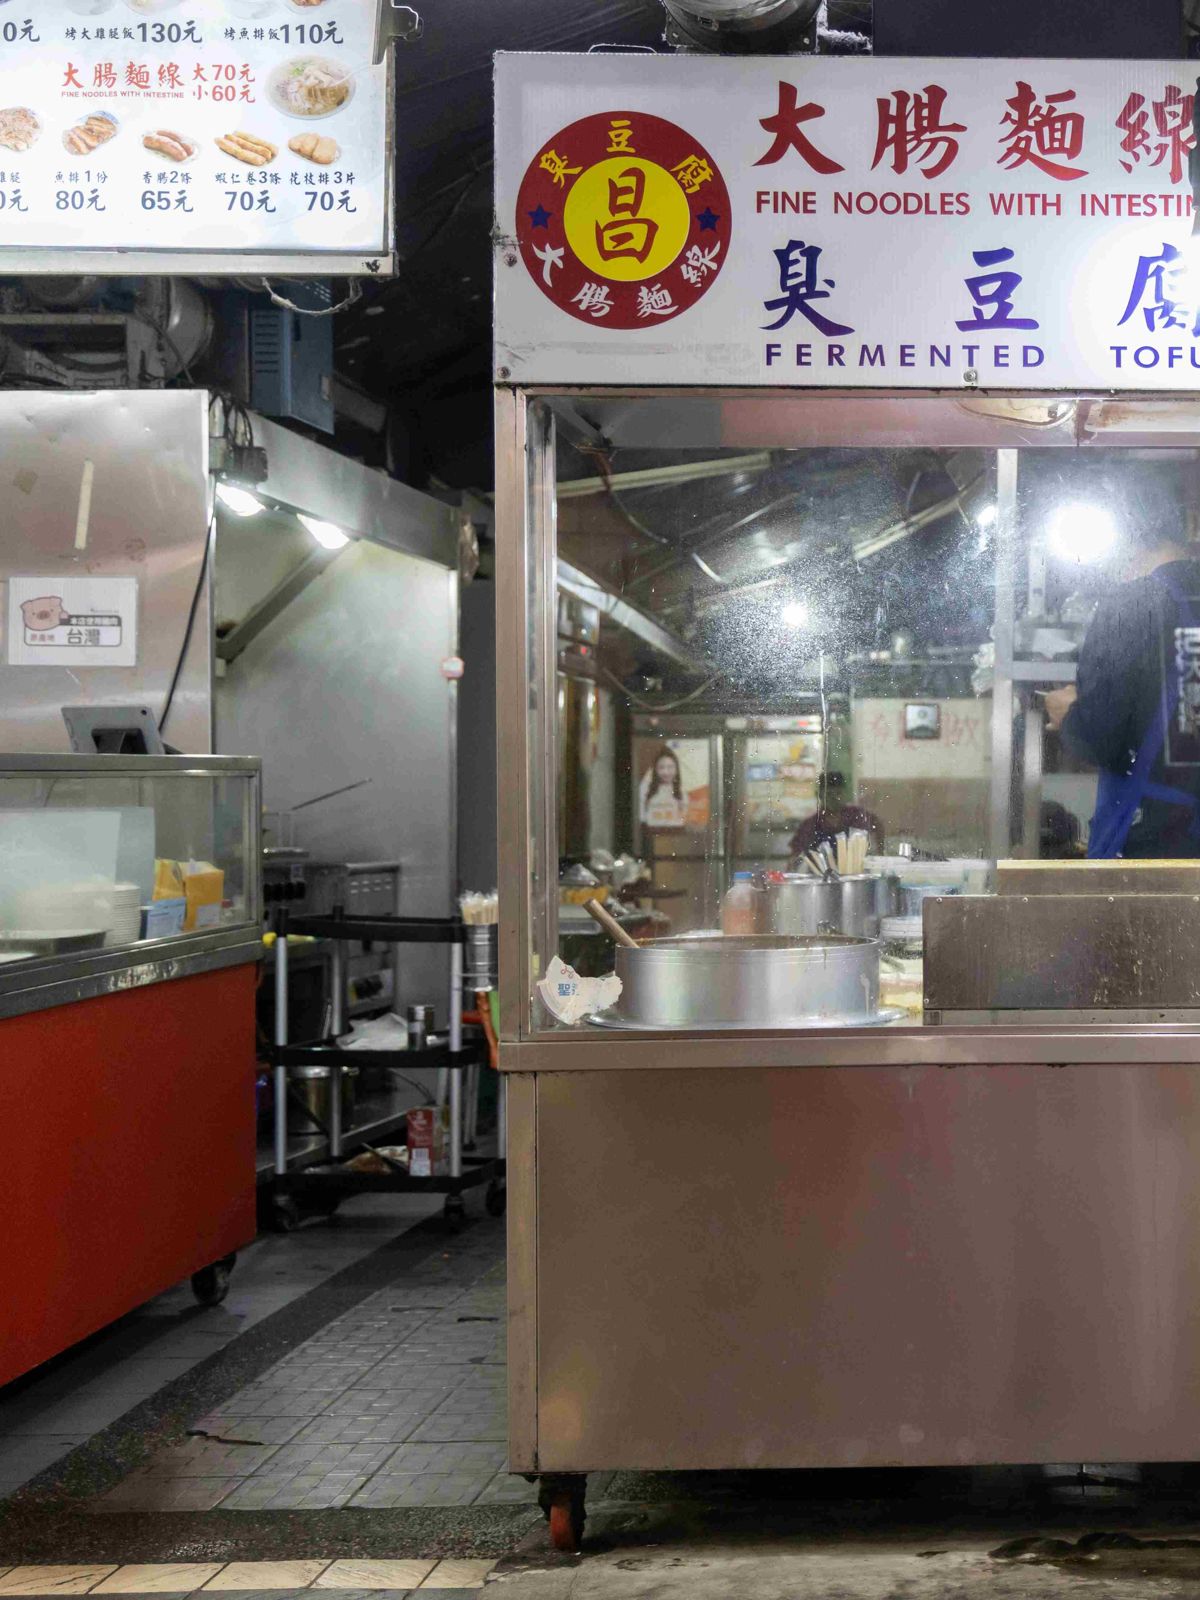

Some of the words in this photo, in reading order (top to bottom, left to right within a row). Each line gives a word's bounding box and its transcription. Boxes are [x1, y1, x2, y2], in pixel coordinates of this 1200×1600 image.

[136, 20, 203, 44] 130元
[279, 20, 345, 44] 110元
[61, 61, 185, 89] 大腸麵線
[192, 62, 256, 83] 大70元
[143, 91, 184, 99] INTESTINE
[192, 85, 256, 103] 小60元
[751, 80, 1198, 185] 大腸麵線
[540, 119, 715, 194] 臭豆腐
[55, 188, 106, 212] 80元
[140, 190, 194, 213] 65元
[224, 190, 277, 213] 70元
[304, 190, 357, 213] 70元
[756, 191, 818, 215] FINE
[833, 191, 971, 216] NOODLES
[990, 193, 1062, 217] WITH
[1081, 193, 1194, 217] INTESTI
[595, 166, 660, 265] 昌
[532, 239, 722, 319] 大腸麵線
[766, 344, 1045, 368] FERMENTED
